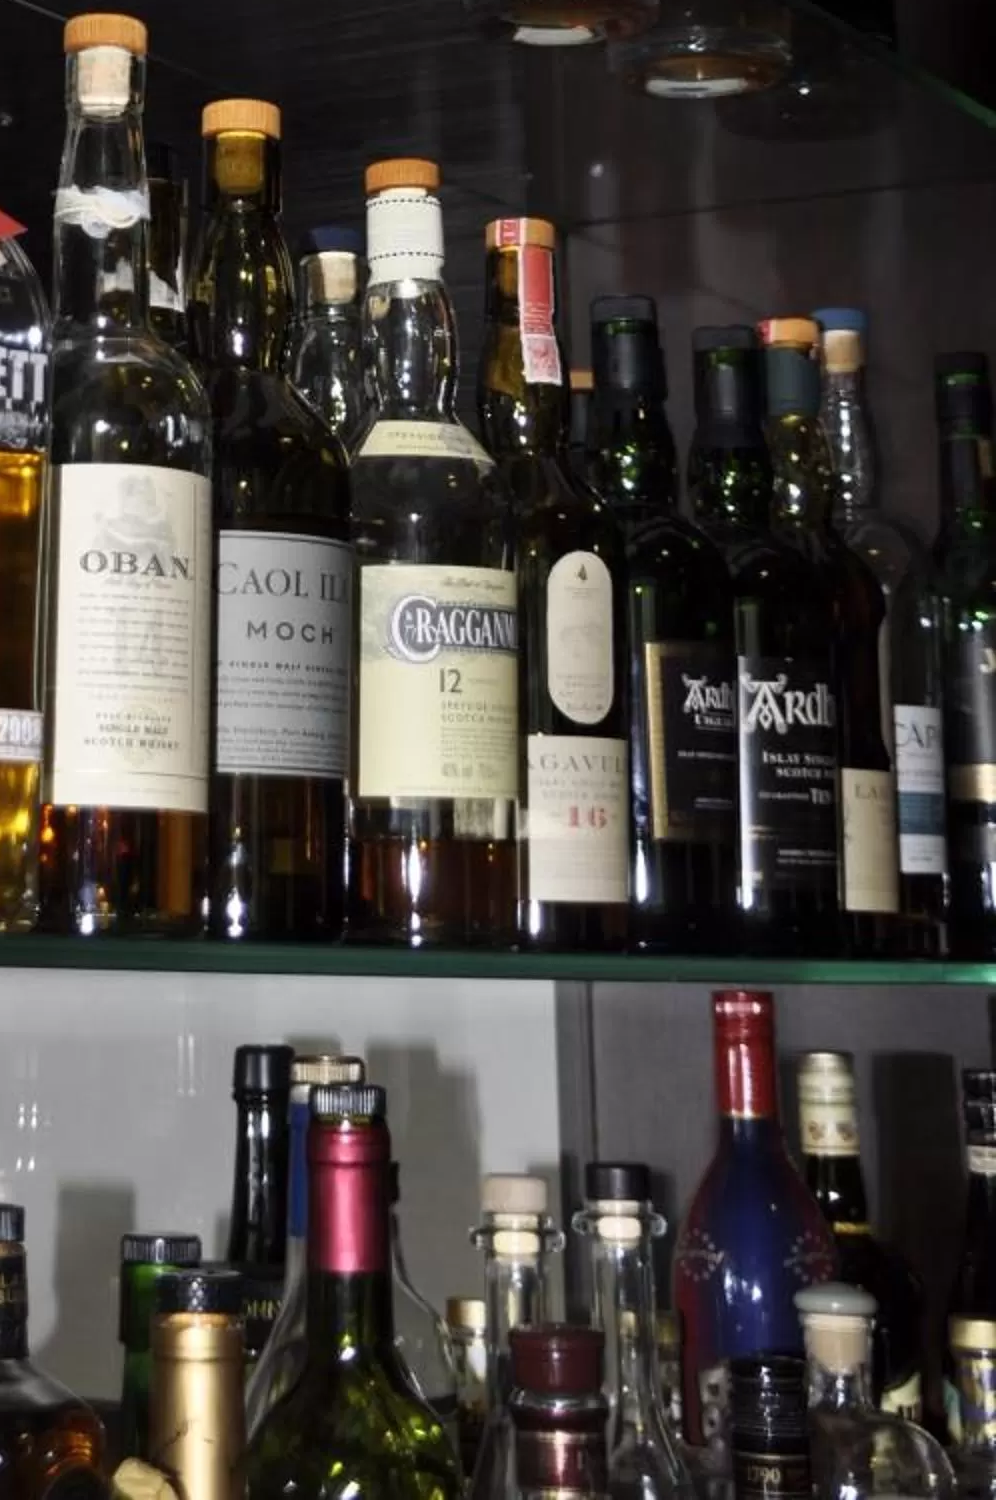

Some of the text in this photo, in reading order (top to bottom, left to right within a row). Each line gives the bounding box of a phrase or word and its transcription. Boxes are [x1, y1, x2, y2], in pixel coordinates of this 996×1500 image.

[78, 549, 193, 581] OBAN
[218, 560, 309, 598] CAOL
[246, 619, 333, 645] MOCH
[439, 667, 464, 694] 12
[567, 805, 610, 830] 16
